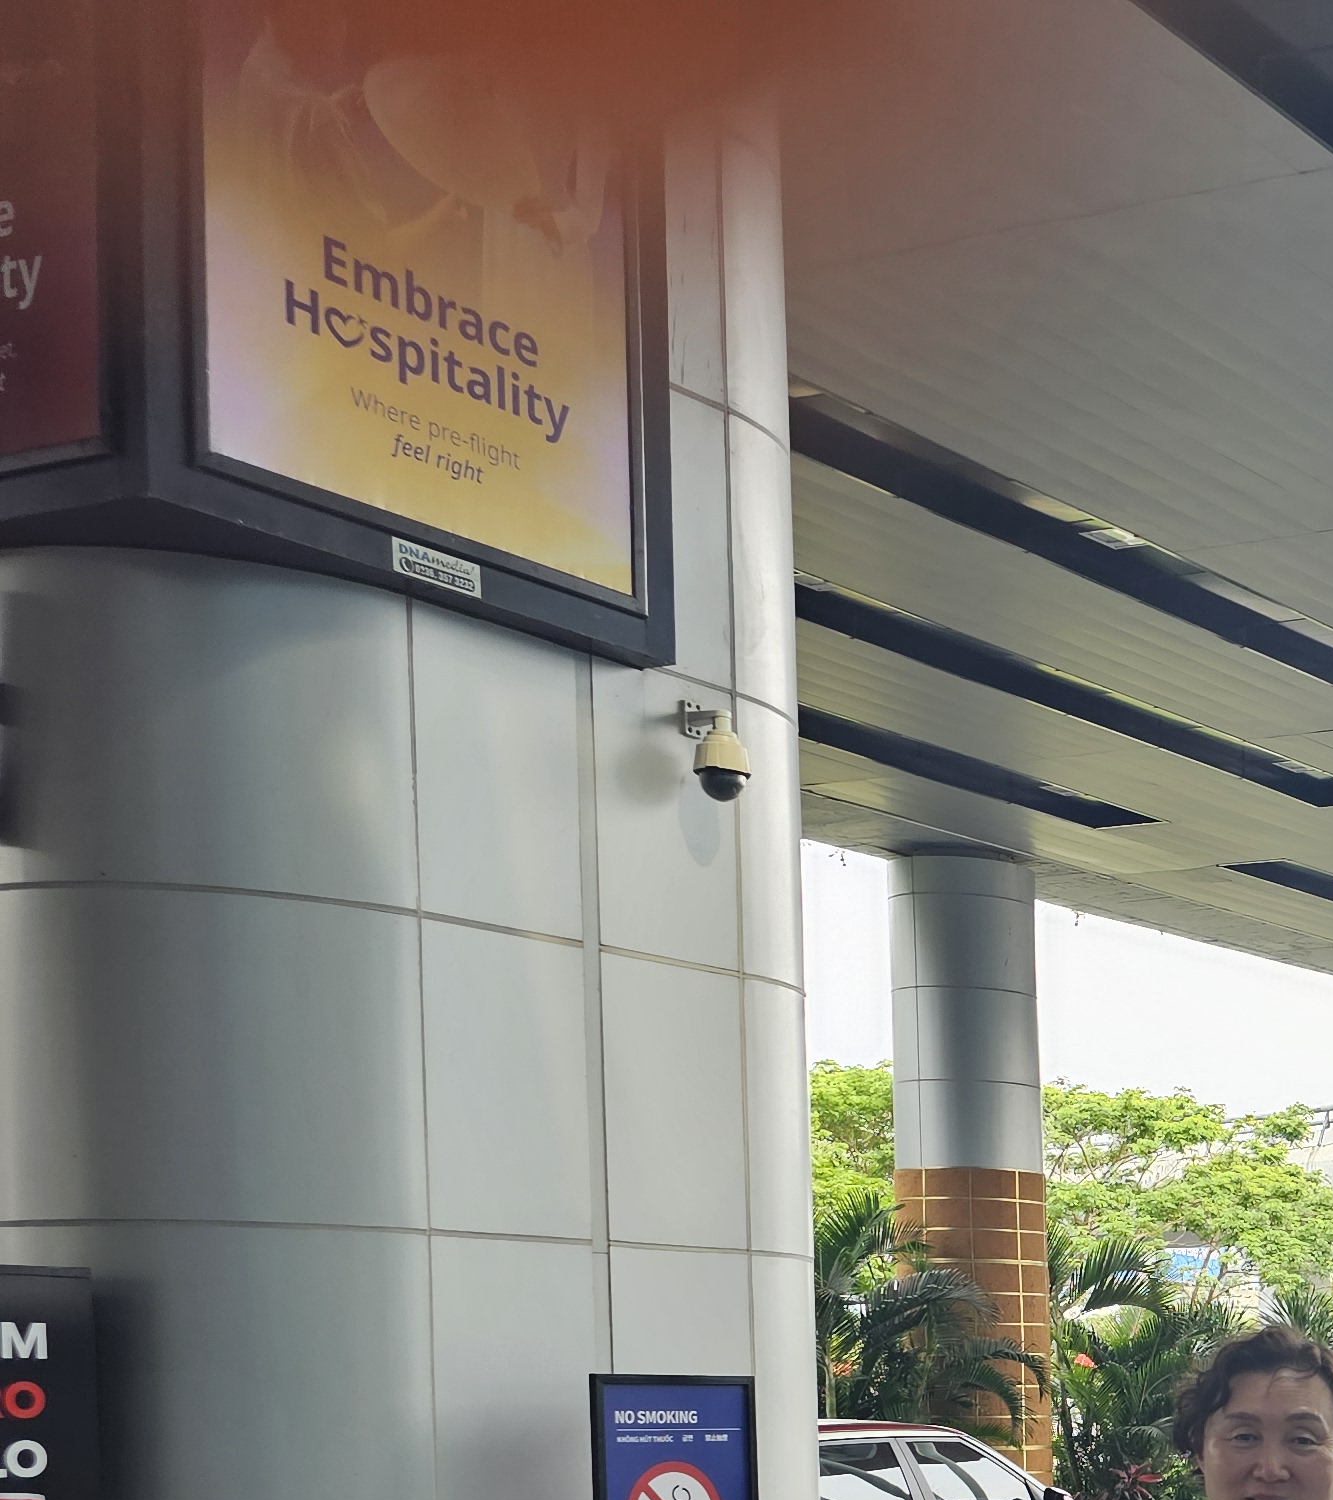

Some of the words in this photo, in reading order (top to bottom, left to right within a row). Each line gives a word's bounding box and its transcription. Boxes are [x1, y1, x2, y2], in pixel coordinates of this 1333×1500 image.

[323, 235, 538, 367] Embrace
[350, 386, 421, 431] Where
[428, 420, 521, 471] pre-flight
[391, 434, 430, 465] feel
[436, 453, 484, 484] right
[614, 1410, 635, 1424] NO
[637, 1410, 698, 1424] SMOKING
